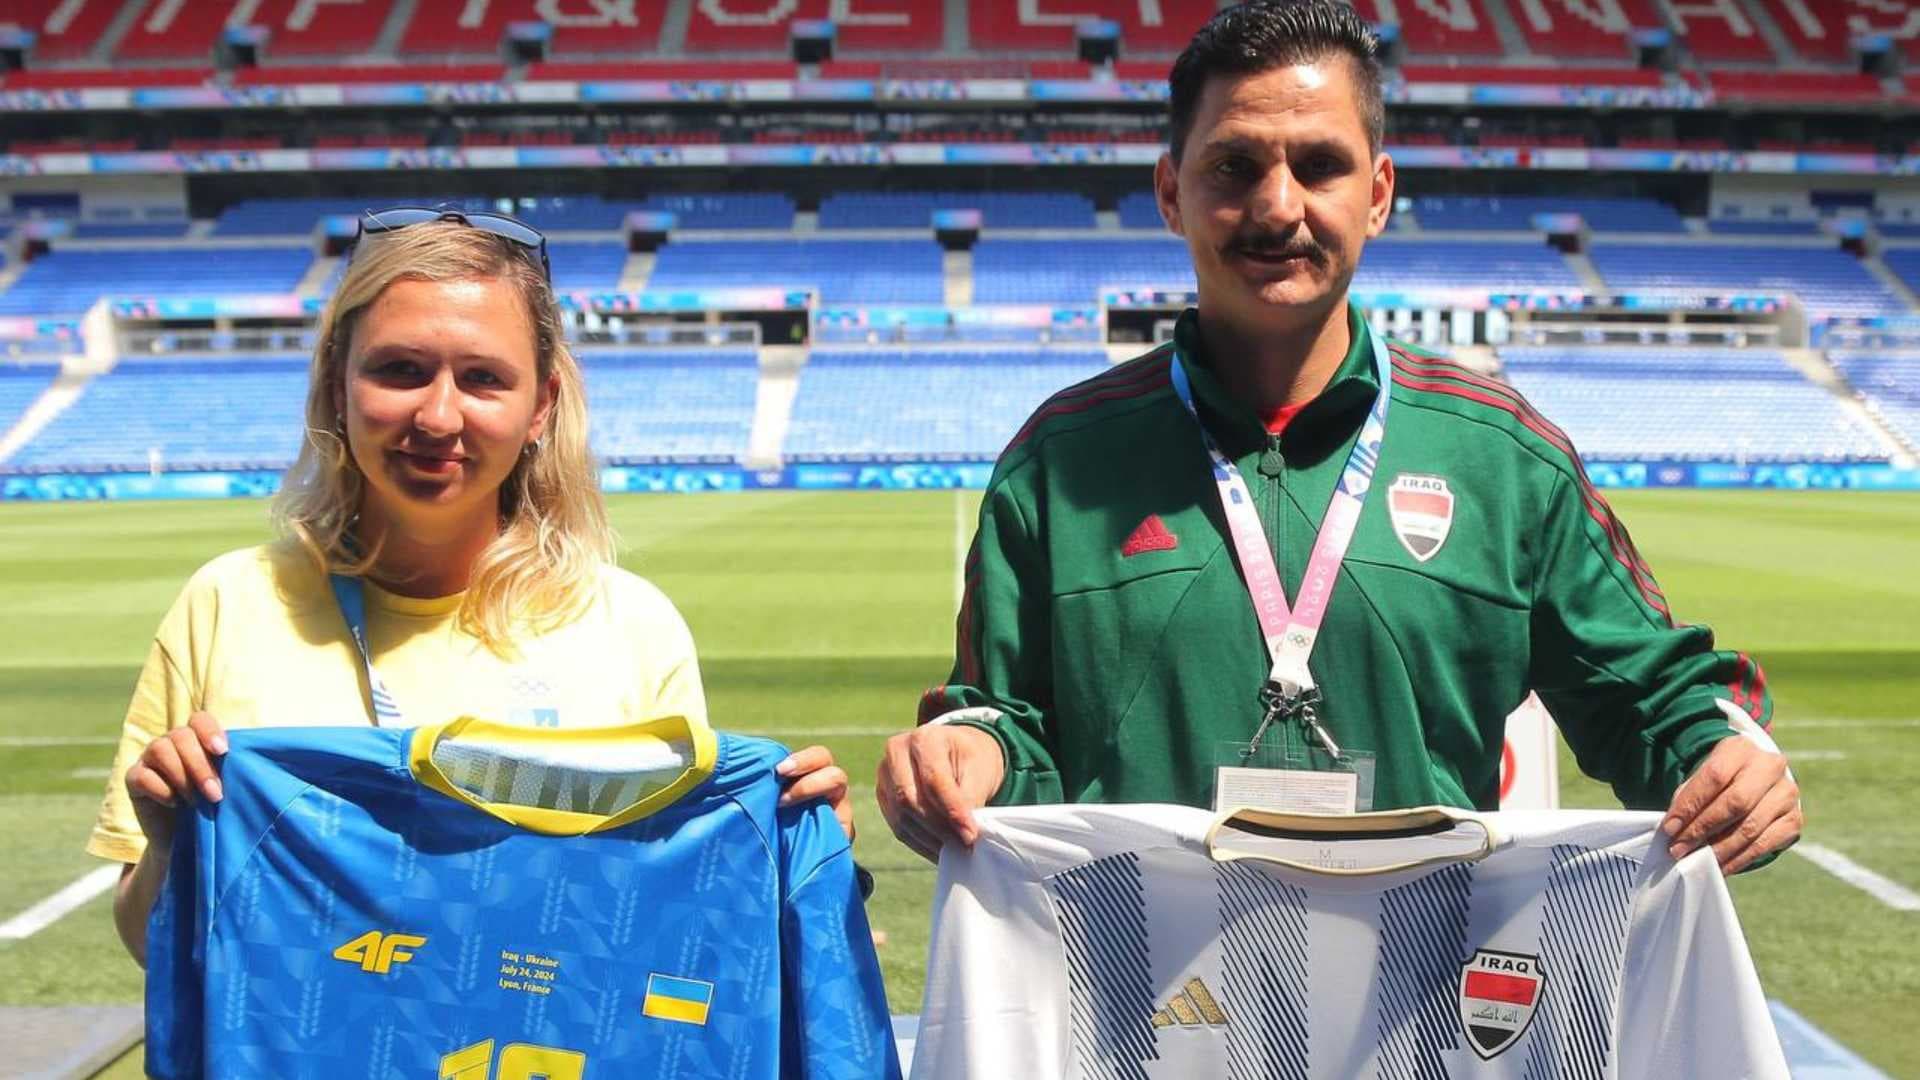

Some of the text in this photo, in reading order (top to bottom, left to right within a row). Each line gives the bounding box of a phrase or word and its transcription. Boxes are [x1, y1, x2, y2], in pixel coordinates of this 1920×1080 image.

[1402, 478, 1443, 491] IRAQ
[333, 930, 427, 974] 4F
[502, 950, 519, 963] Iraq
[526, 953, 559, 967] Ukraine
[501, 964, 518, 977] July
[533, 970, 554, 980] 2024
[1480, 956, 1529, 974] IRAQ
[499, 977, 551, 994] Lyon, France
